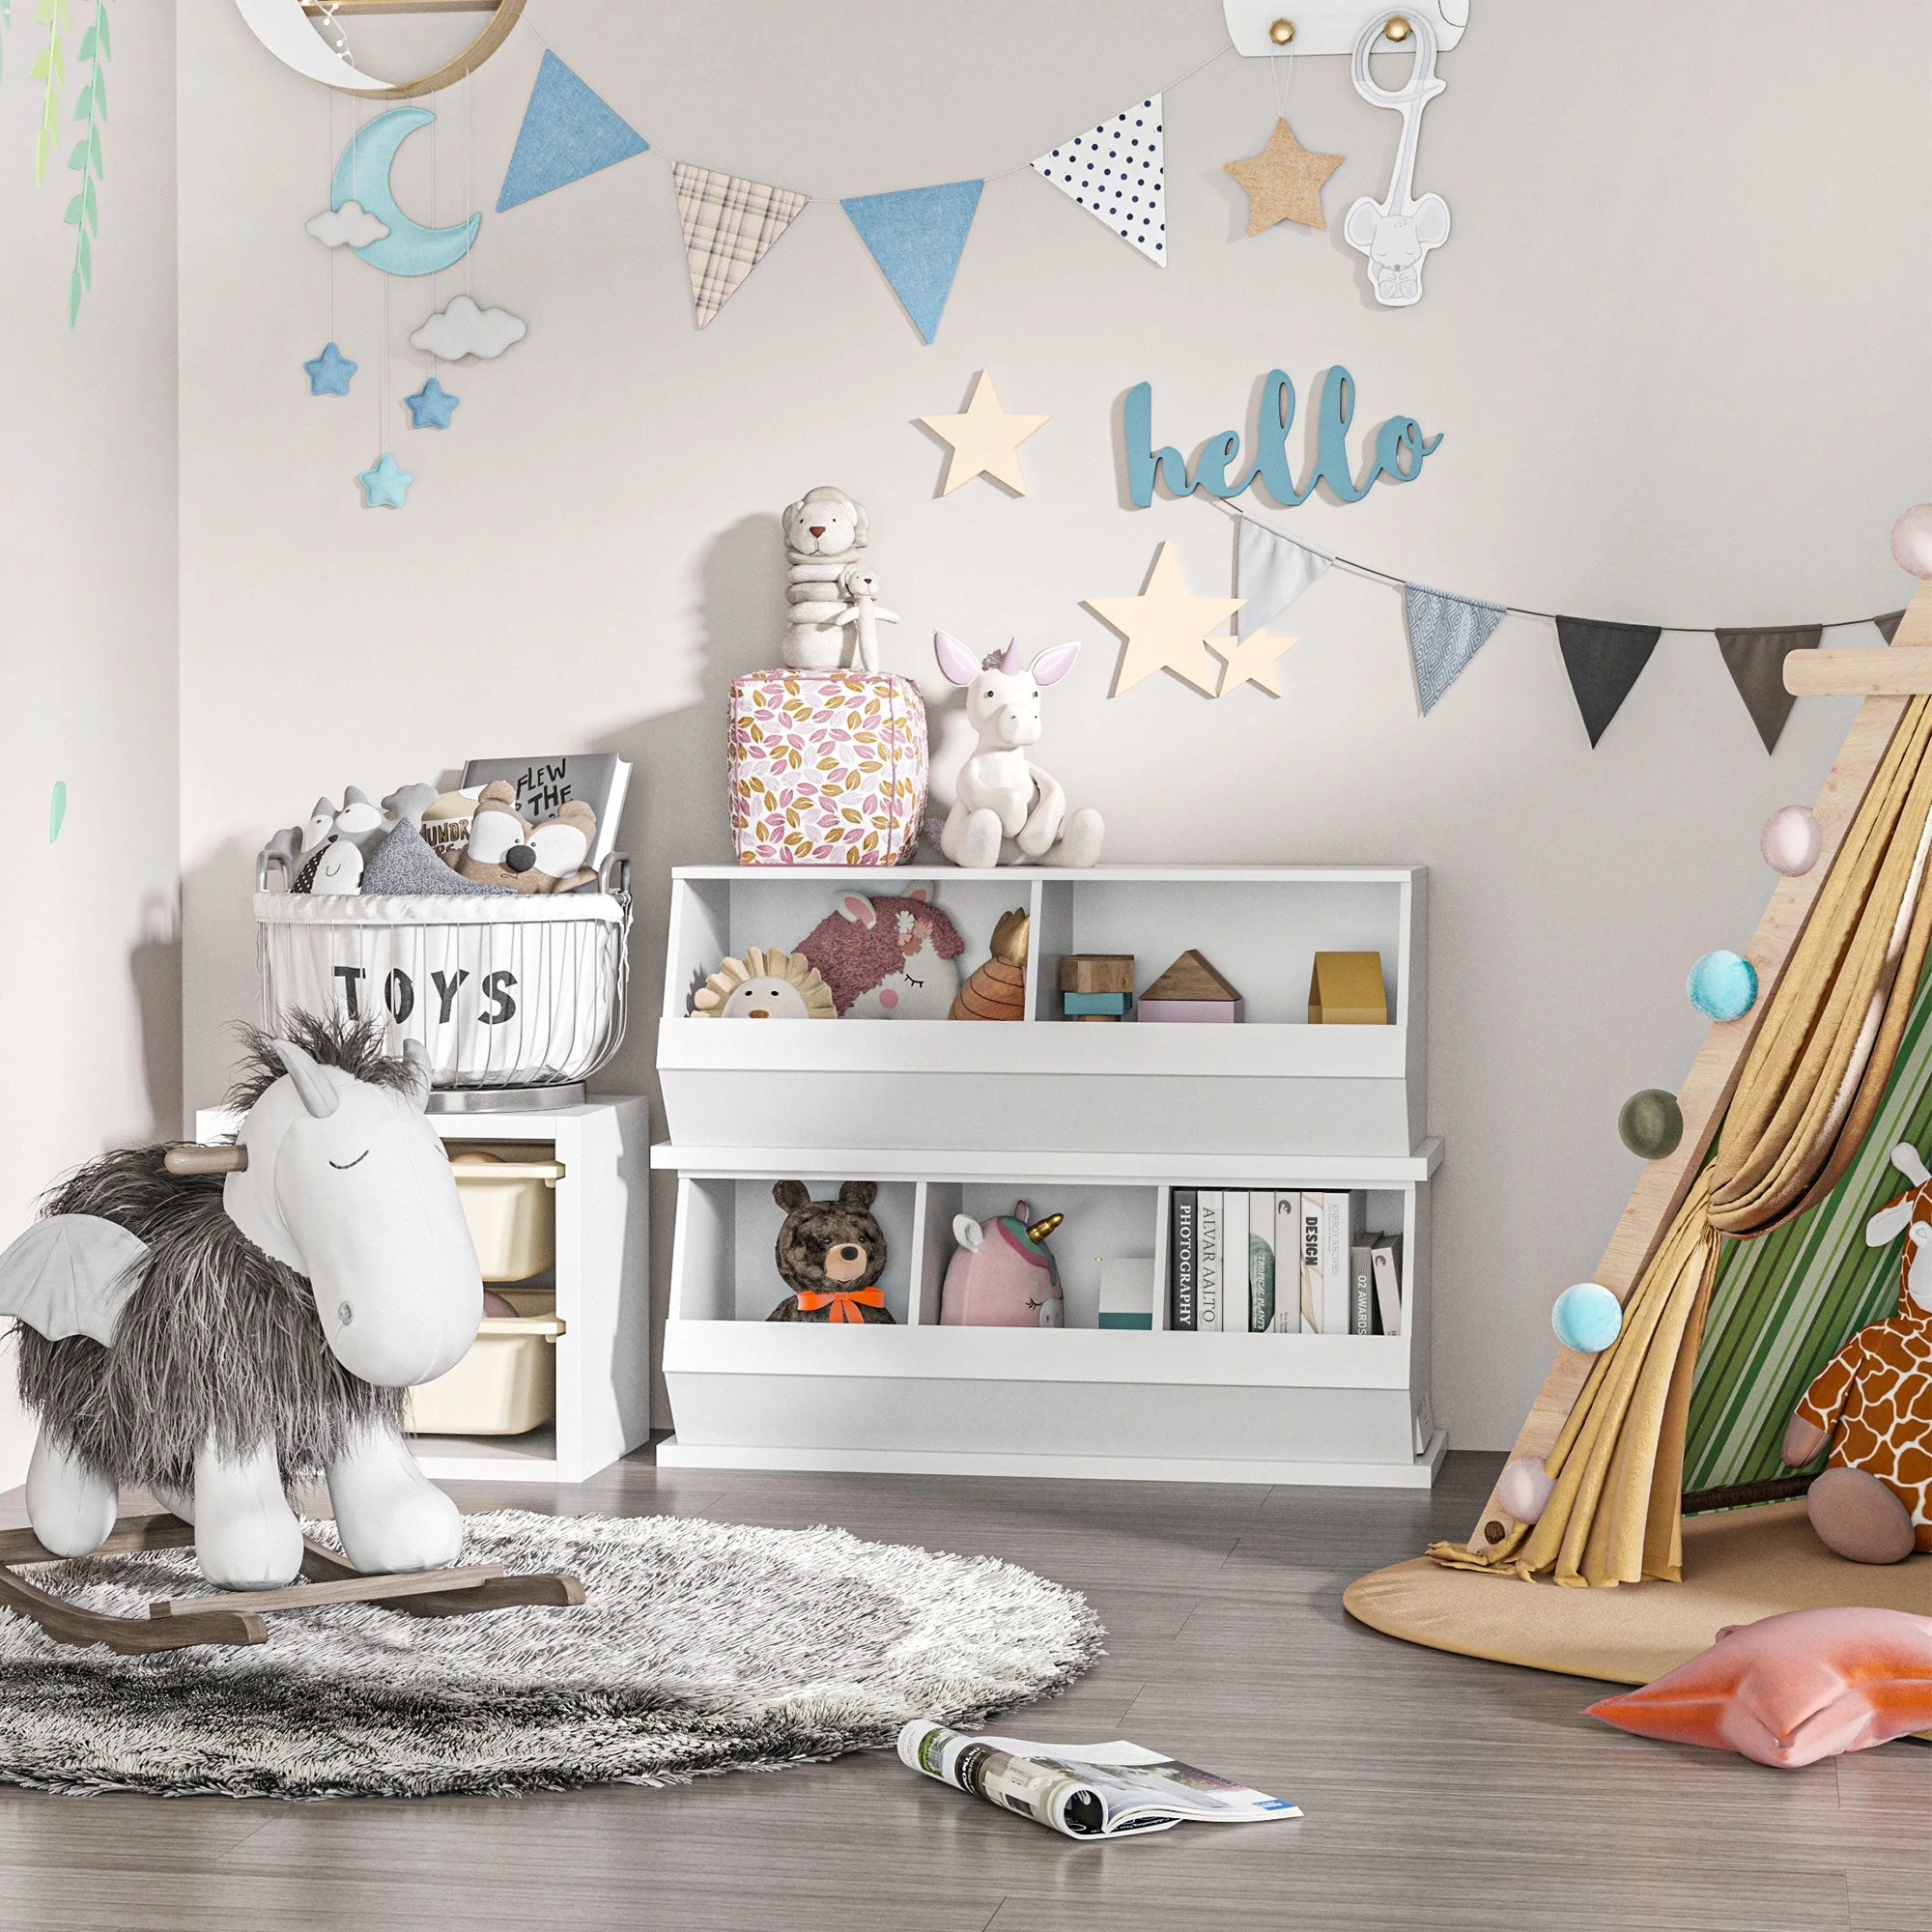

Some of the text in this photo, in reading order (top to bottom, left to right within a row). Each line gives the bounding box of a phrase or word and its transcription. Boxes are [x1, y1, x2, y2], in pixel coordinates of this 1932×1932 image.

[1124, 364, 1444, 508] hello
[515, 757, 566, 801] FLEW
[527, 784, 574, 816] THE
[333, 965, 518, 1025] TOYS
[1179, 1205, 1191, 1325] PHOTOGRAPHY
[1203, 1207, 1216, 1322] ALVAR AALTO
[1305, 1216, 1319, 1265] DESIGN
[1257, 1255, 1265, 1330] TROPICAL PLANTS
[1357, 1291, 1368, 1335] AWARDS
